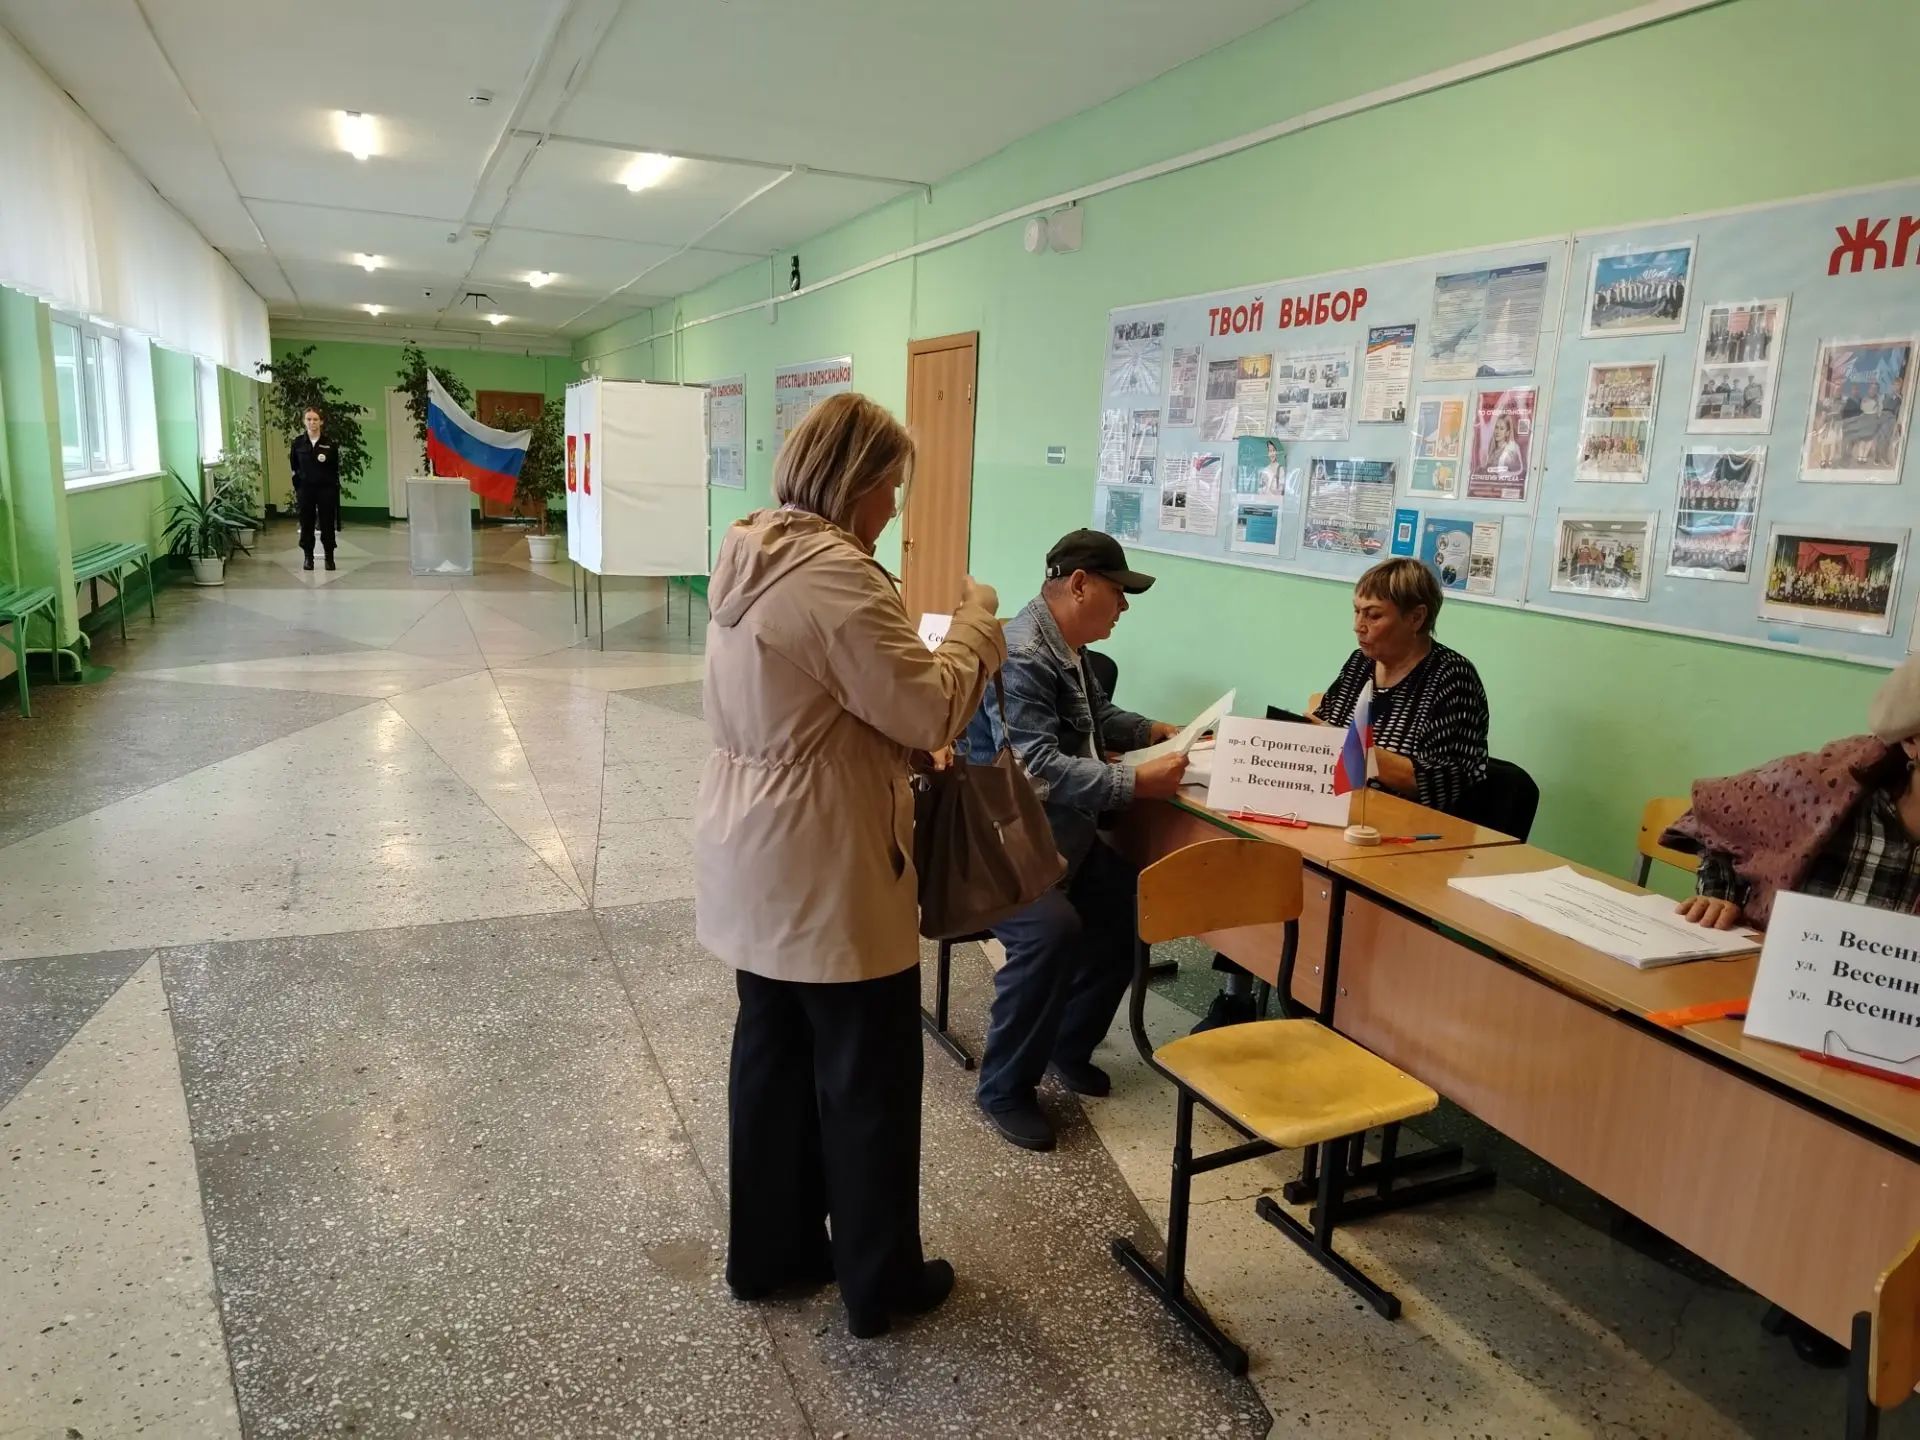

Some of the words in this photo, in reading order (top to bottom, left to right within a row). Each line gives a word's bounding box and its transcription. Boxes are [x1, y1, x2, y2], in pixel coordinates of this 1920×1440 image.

[1209, 296, 1264, 337] ТВОЙ
[1279, 288, 1368, 329] ВЫБОР
[1250, 755, 1317, 774] Весенняя,
[1247, 774, 1315, 793] Весенняя,
[1801, 931, 1824, 942] ул.
[1795, 960, 1816, 972] ул.
[1788, 989, 1810, 1001] ул.
